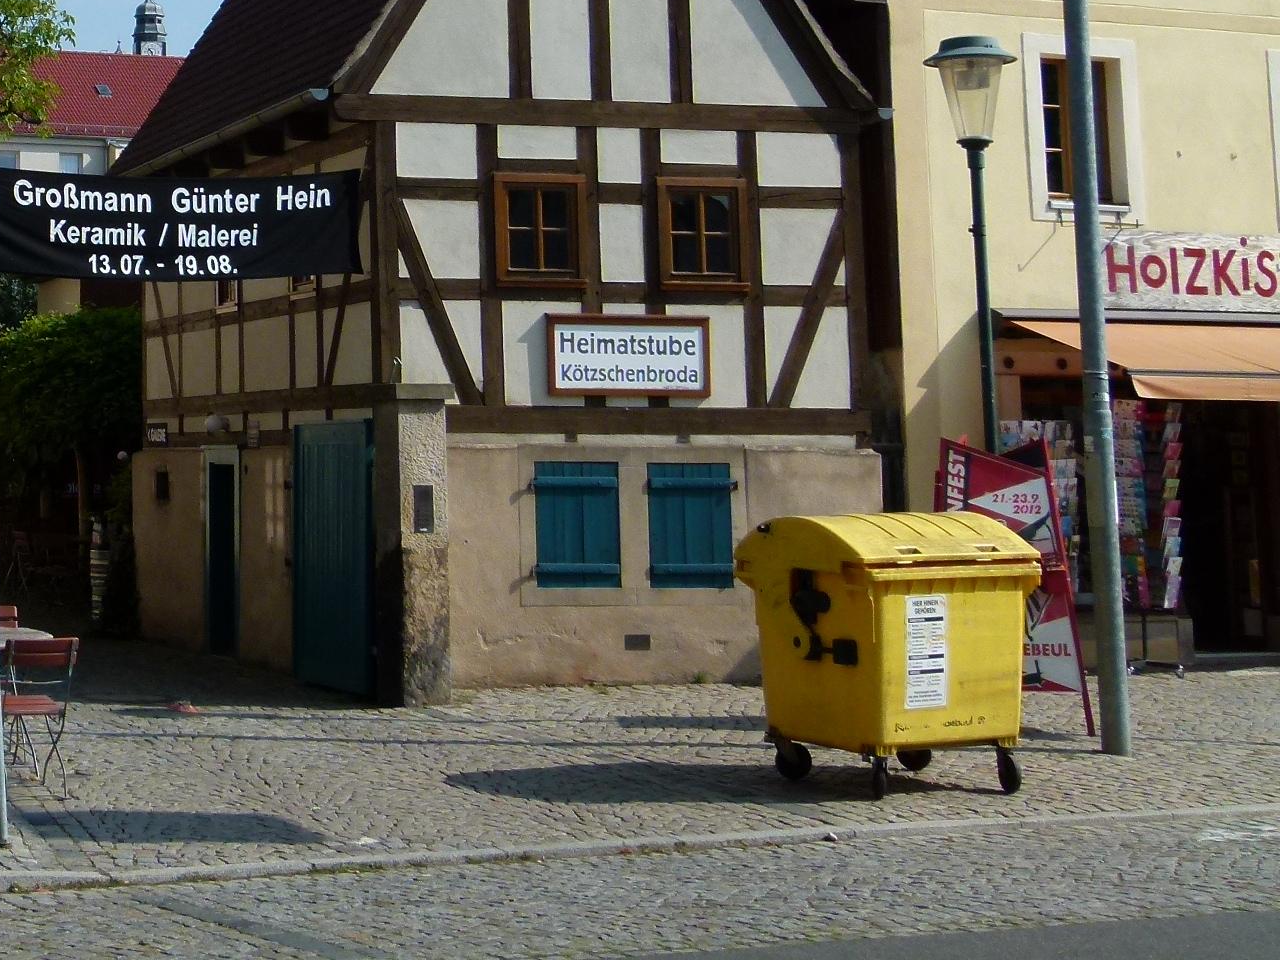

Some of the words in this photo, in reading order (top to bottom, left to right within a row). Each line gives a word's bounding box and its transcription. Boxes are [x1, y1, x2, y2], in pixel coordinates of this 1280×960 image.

[13, 178, 152, 214] Großmann
[171, 187, 261, 214] Günter
[276, 183, 331, 211] Hein
[48, 218, 147, 247] Keramik
[158, 222, 169, 247] /
[177, 223, 259, 247] Malerei
[88, 253, 151, 276] 13.07.
[174, 254, 239, 276] 19.08.
[559, 331, 696, 356] Heimatstube
[560, 363, 699, 384] Kötzschenbroda
[1012, 504, 1042, 515] 2012
